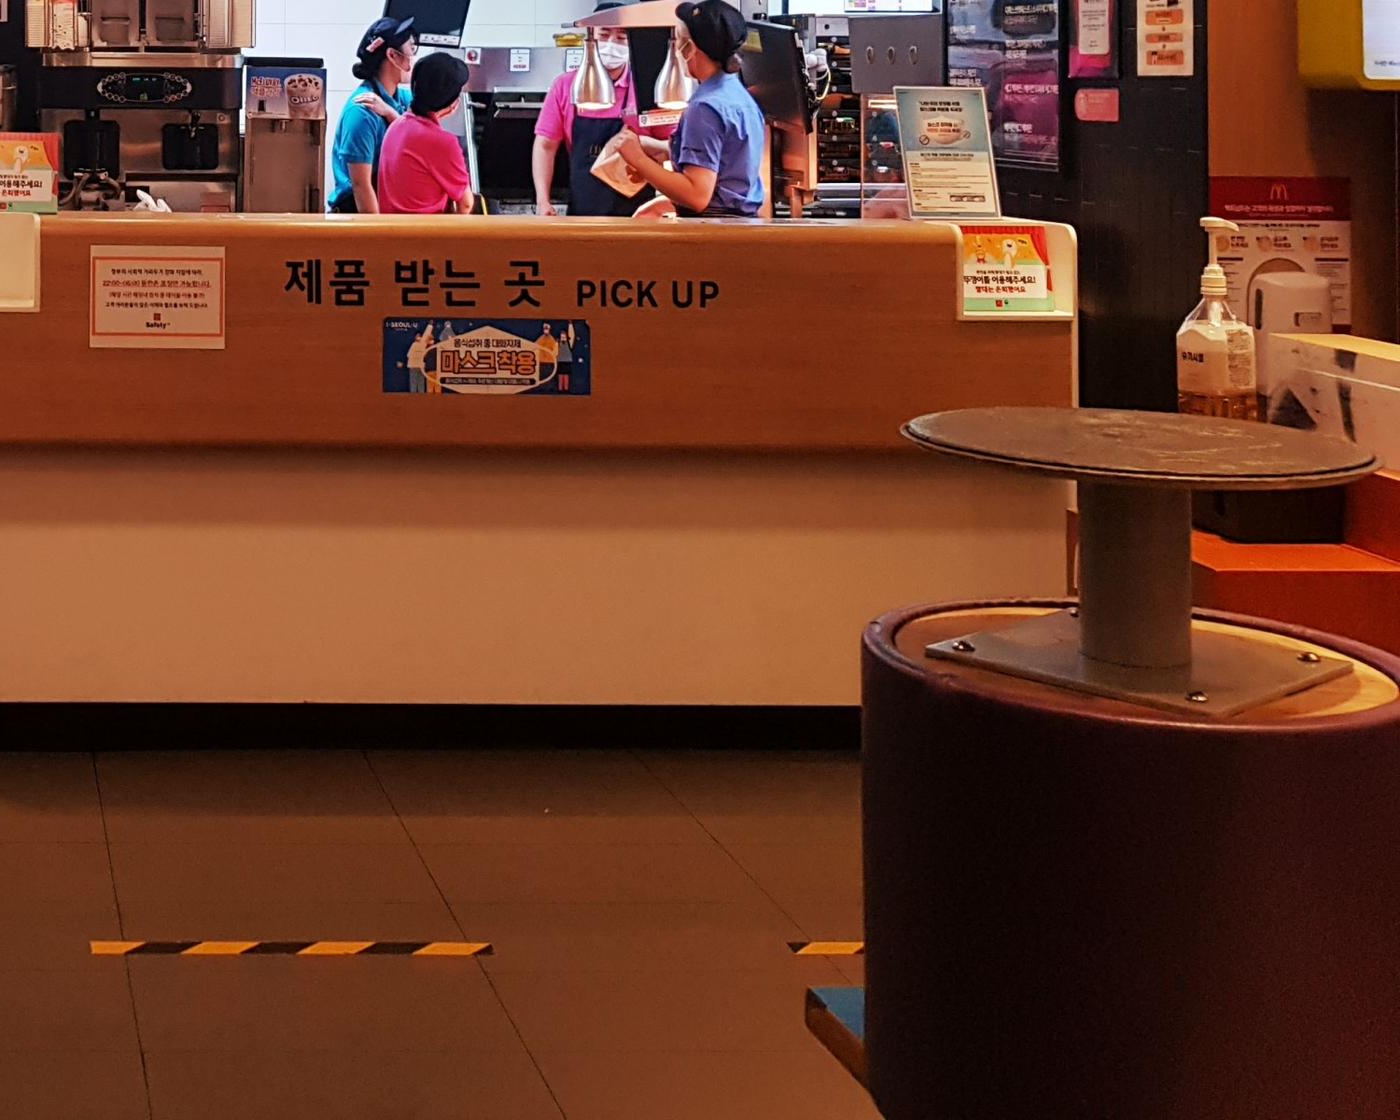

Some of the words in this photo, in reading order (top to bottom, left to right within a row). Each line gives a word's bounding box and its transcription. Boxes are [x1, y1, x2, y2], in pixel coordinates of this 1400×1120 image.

[284, 259, 370, 307] 제품
[393, 259, 481, 307] 받는
[503, 260, 545, 307] 곳
[576, 279, 659, 309] PICK
[671, 279, 720, 309] UP
[440, 350, 497, 375] 마스크
[496, 350, 536, 375] 착용
